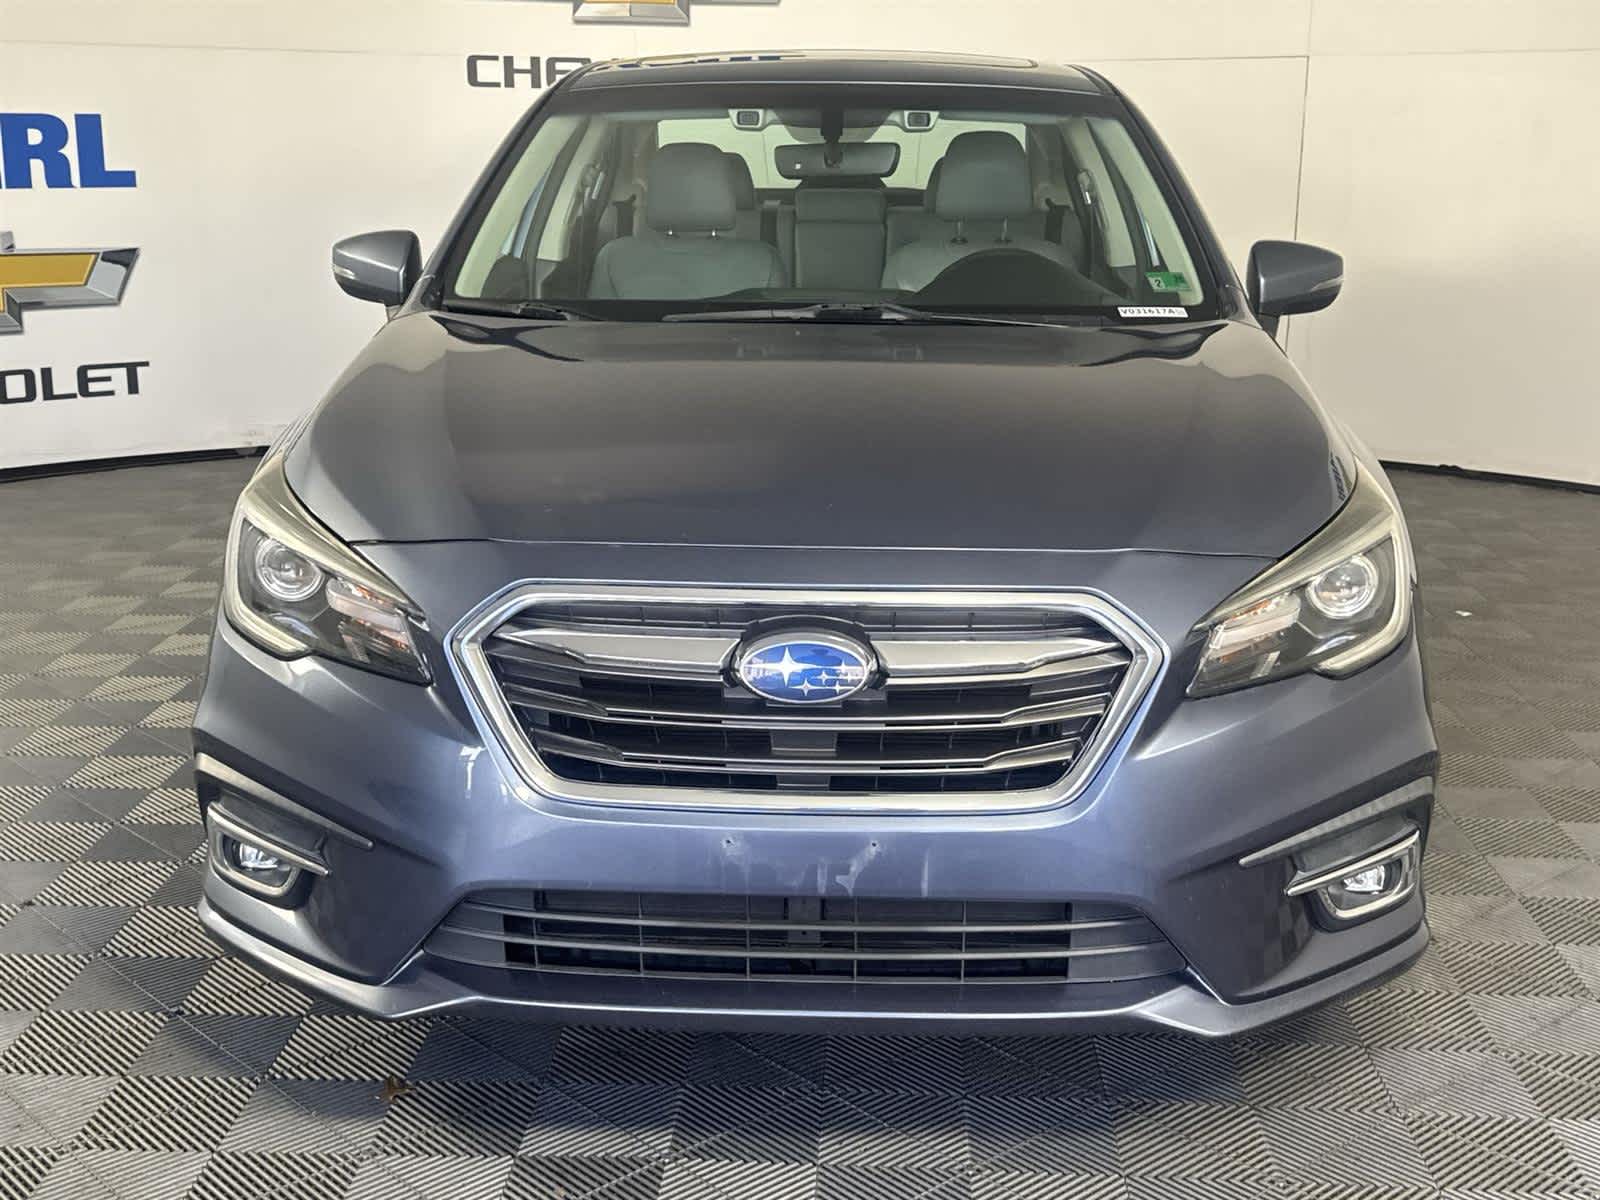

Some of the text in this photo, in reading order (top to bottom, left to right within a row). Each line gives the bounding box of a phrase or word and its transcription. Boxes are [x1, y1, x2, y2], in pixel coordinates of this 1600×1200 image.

[466, 54, 591, 88] CHE
[0, 113, 137, 188] RL
[0, 361, 150, 404] OLET
